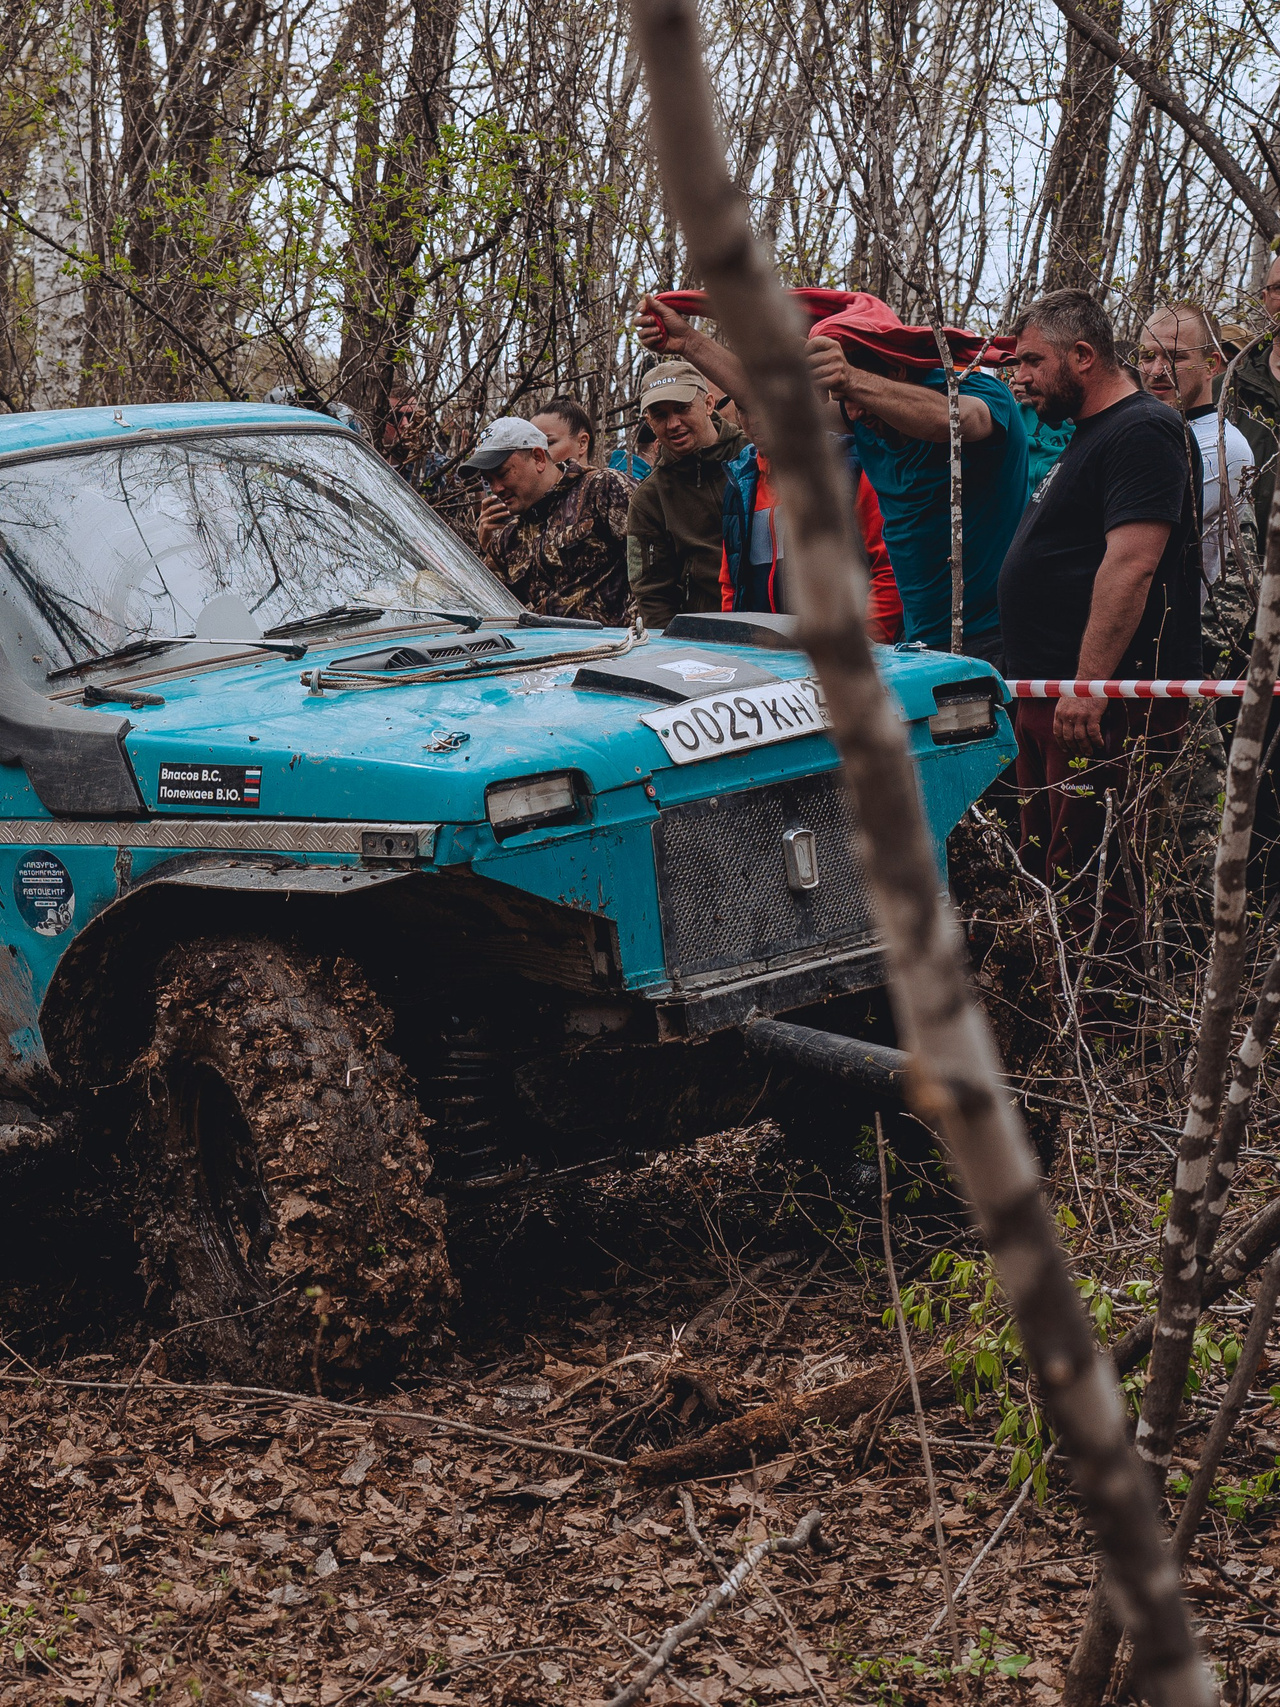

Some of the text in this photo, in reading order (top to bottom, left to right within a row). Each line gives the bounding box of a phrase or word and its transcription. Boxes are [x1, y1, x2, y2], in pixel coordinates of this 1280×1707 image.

[161, 768, 222, 782] Власов В.С.
[160, 786, 241, 801] Полежаев В.Ю.
[22, 888, 66, 896] АВТОЦЕНТР
